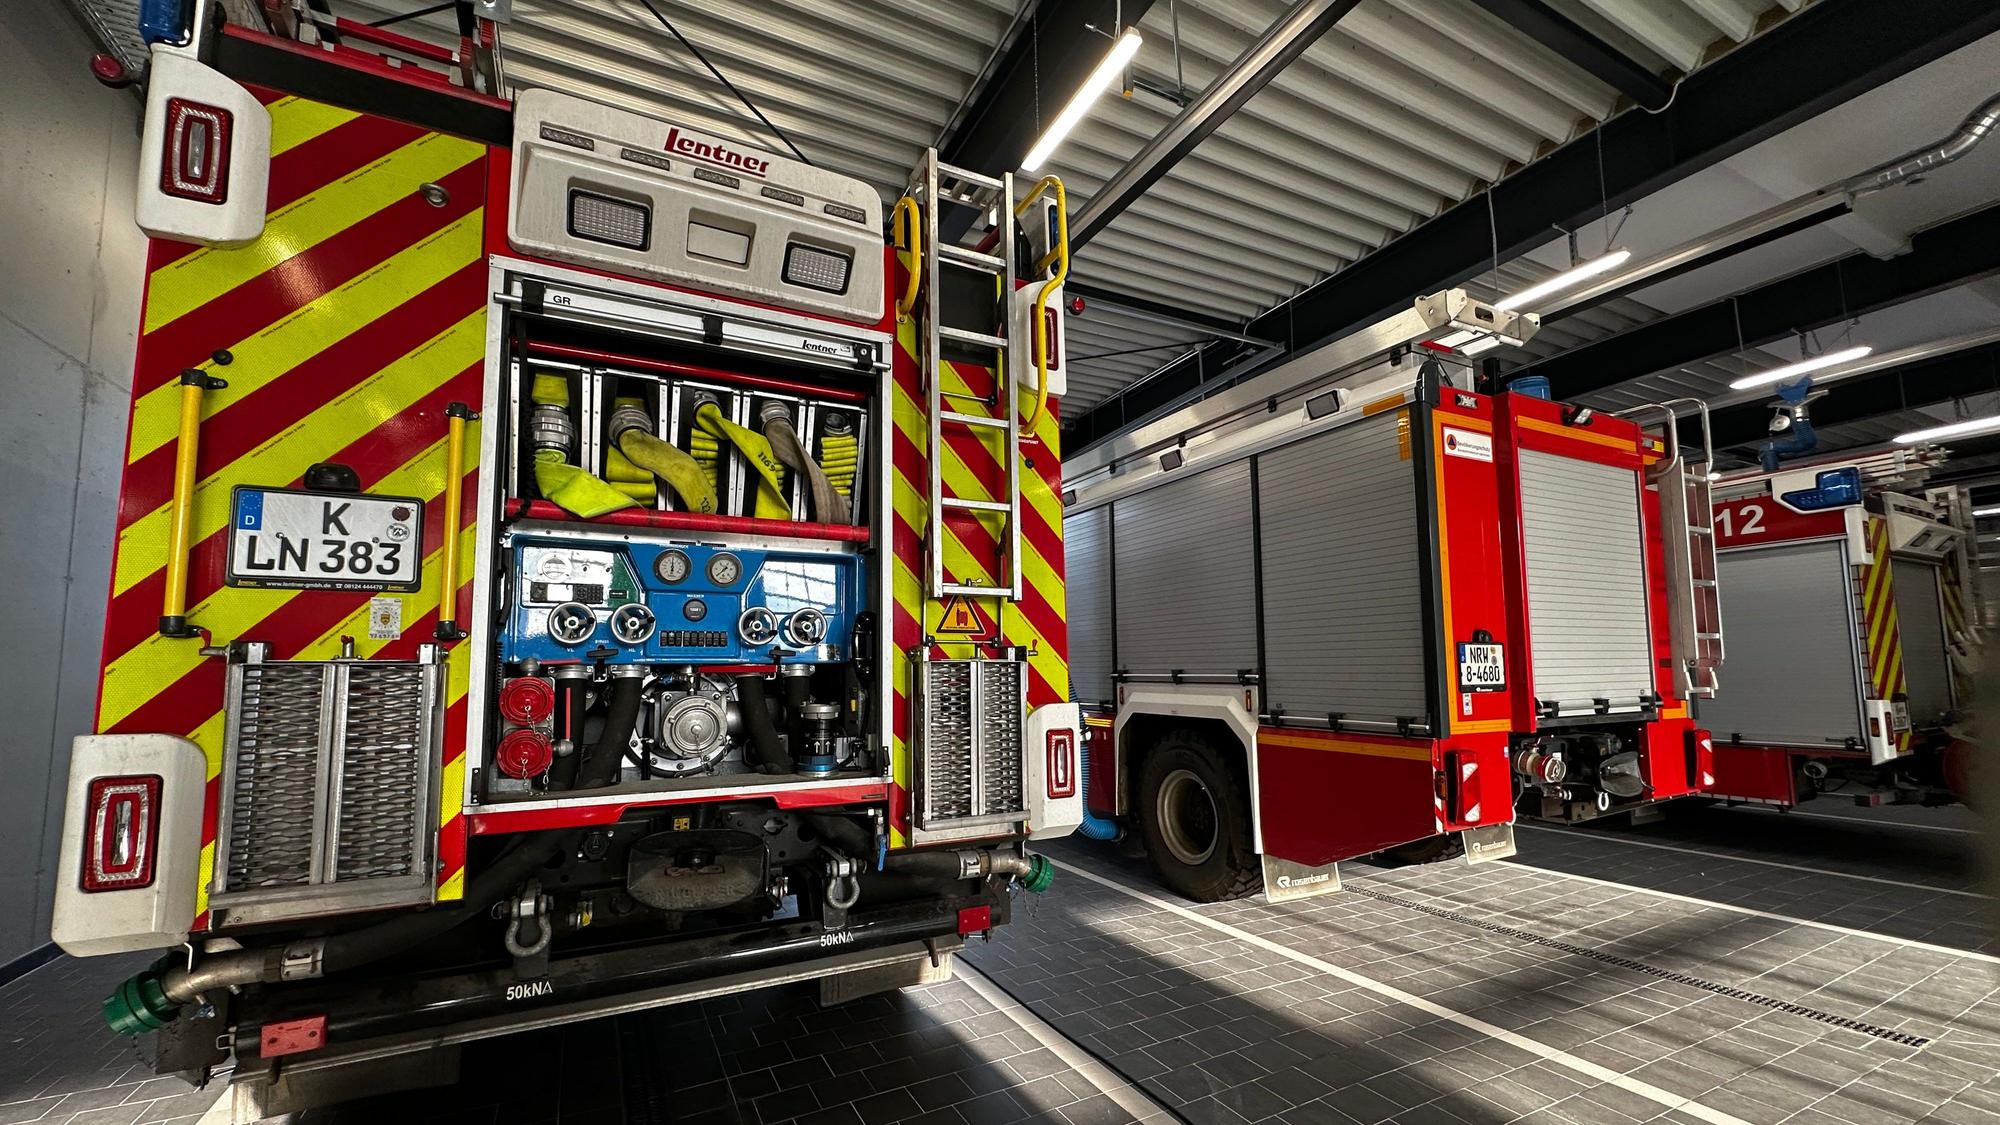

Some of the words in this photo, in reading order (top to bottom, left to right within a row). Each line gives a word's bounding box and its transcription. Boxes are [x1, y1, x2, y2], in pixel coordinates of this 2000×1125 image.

[664, 128, 769, 177] Lentner
[553, 295, 571, 305] GR
[757, 451, 776, 472] 1169
[245, 515, 255, 526] D
[322, 501, 351, 536] K
[1715, 505, 1766, 537] 12
[247, 535, 309, 572] LN
[319, 539, 401, 575] 383
[1470, 646, 1489, 664] NRW
[1466, 665, 1500, 683] 8-4680
[1291, 873, 1329, 887] rosenbauer
